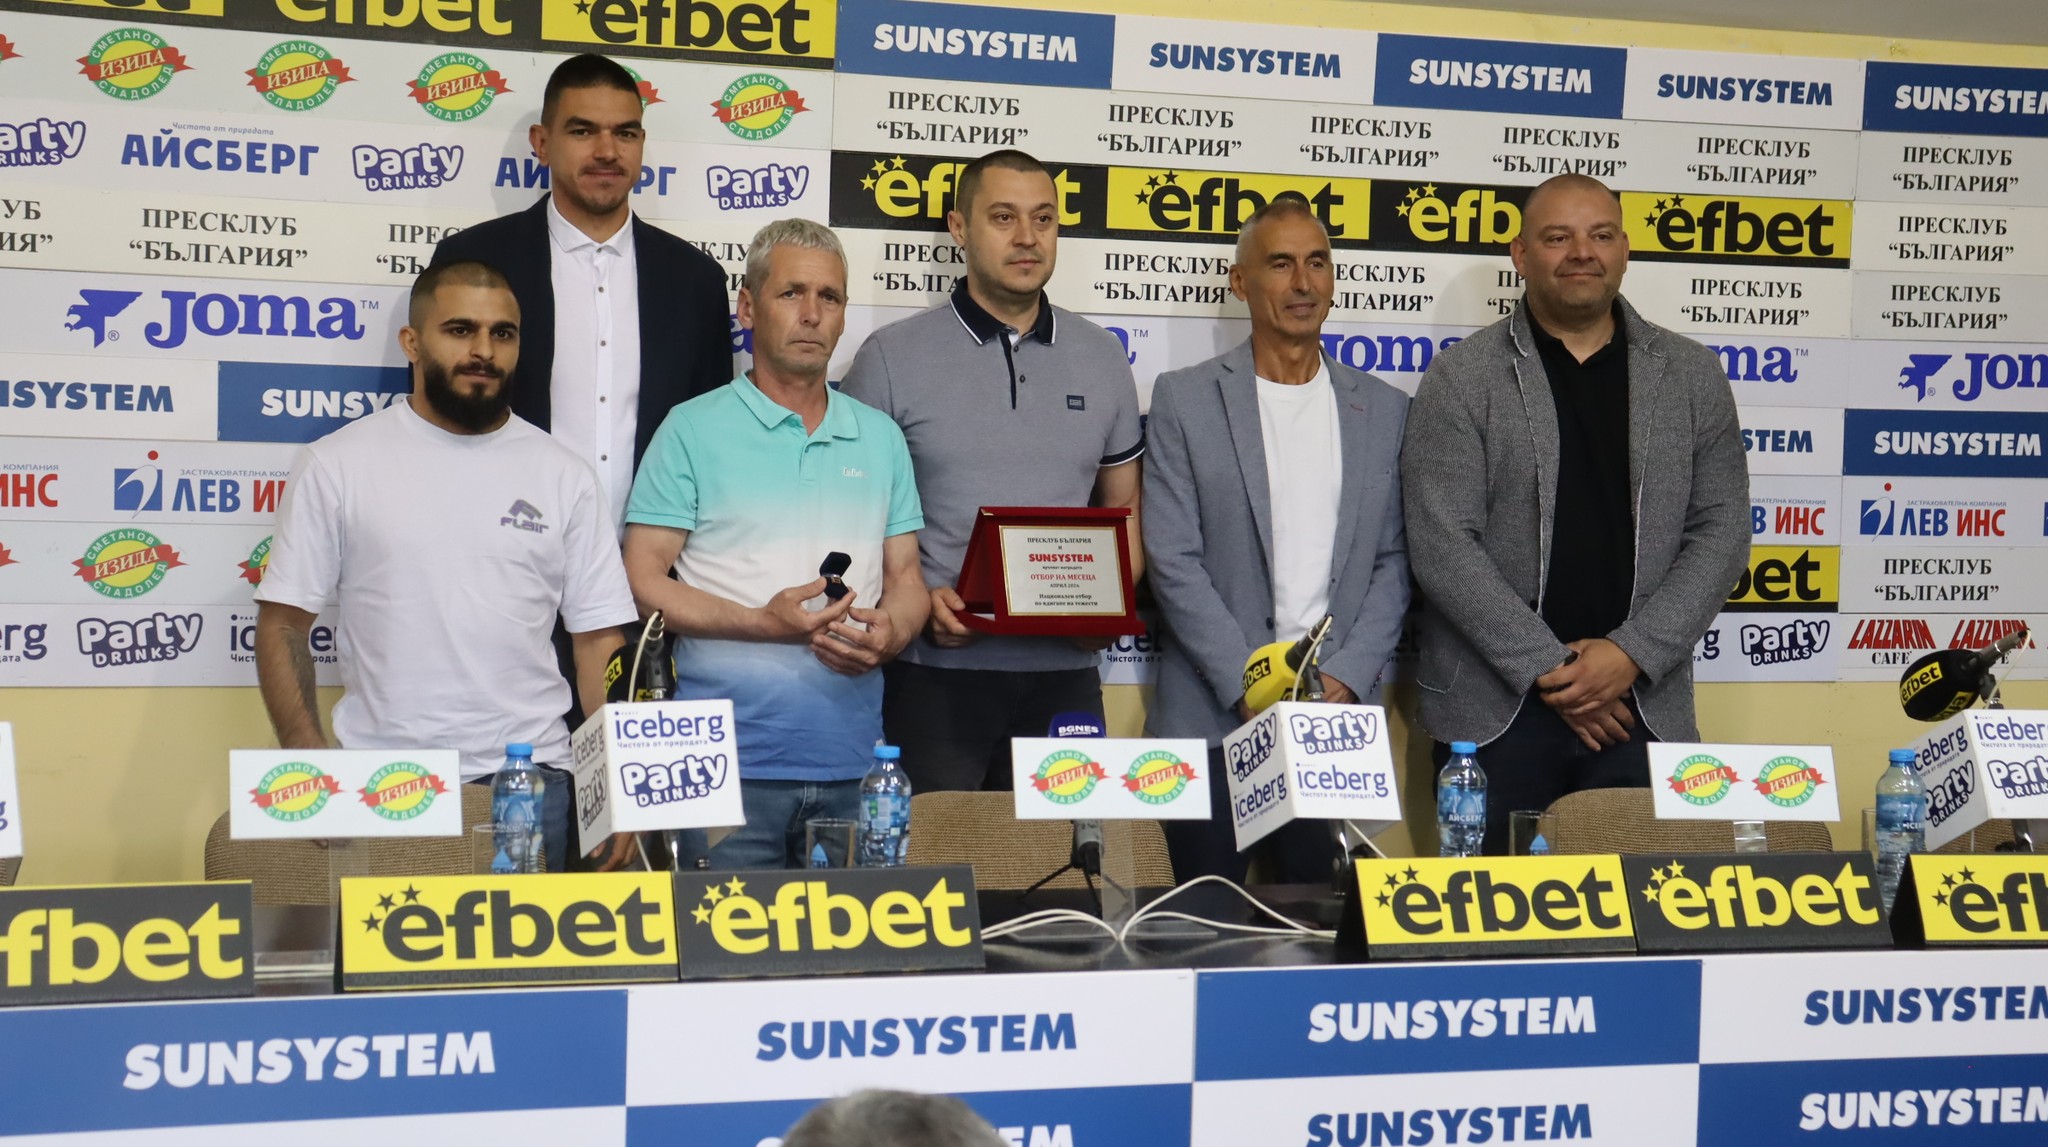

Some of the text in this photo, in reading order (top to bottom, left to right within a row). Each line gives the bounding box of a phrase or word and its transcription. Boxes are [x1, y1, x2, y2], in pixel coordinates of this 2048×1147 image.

[91, 29, 161, 59] СМЕТАНОВ
[260, 42, 326, 71] СМЕТАНОВ
[873, 23, 1078, 63] SUNSYSTEM
[99, 48, 166, 78] ИЗИДА
[420, 54, 483, 82] СМЕТАНОВ
[1149, 42, 1341, 78] SUNSYSTEM
[98, 63, 174, 100] СЛАДОЛЕД
[267, 61, 330, 90] ИЗИДА
[426, 73, 488, 100] ИЗИДА
[724, 76, 783, 102] СМЕТАНОВ
[1408, 58, 1592, 94] SUNSYSTEM
[1657, 73, 1833, 106] SUNSYSTEM
[265, 77, 338, 111] СЛАДОЛЕД
[425, 89, 495, 121] СЛАДОЛЕД
[729, 92, 788, 120] ИЗИДА
[888, 91, 1020, 116] ПРЕСКЛУБ
[728, 107, 794, 140] СЛАДОЛЕД
[1108, 104, 1235, 129] ПРЕСКЛУБ
[1311, 116, 1432, 139] ПРЕСКЛУБ
[0, 119, 85, 157] arty
[121, 128, 319, 176] АЙСБЕРГ
[1503, 126, 1620, 150] ПРЕСКЛУБ
[1697, 136, 1811, 159] ПРЕСКЛУБ
[354, 145, 463, 180] Party
[1902, 146, 2013, 167] ПРЕСКЛУБ
[369, 176, 441, 190] DRINKS
[708, 165, 808, 198] Party
[721, 196, 788, 209] DRINKS
[1149, 177, 1345, 237] efbt
[142, 208, 297, 236] ПРЕСКЛУБ
[1656, 200, 1834, 256] efbet
[1898, 215, 2008, 236] ПРЕСКЛУБ
[884, 243, 967, 264] ПРЕСК
[1104, 253, 1229, 276] ПРЕСКЛУБ
[1335, 263, 1425, 284] ЕСКЛУБ
[1690, 278, 1803, 300] ПРЕСКЛУБ
[1891, 283, 2001, 305] ПРЕСКЛУБ
[144, 290, 366, 349] Joma
[261, 388, 405, 420] SUNSY
[1874, 430, 2041, 456] SUNSYSTEM
[180, 469, 267, 477] ЗАСТРАХОВАТЕЛНА
[172, 478, 241, 512] ЛЕВ
[1775, 506, 1826, 536] ИНС
[1900, 508, 2006, 537] ЛЕВ ИНС
[87, 531, 154, 560] СМЕТАНОВ
[1028, 553, 1094, 562] SUNSYSTEM
[93, 548, 160, 578] ИЗИДА
[1884, 559, 1992, 575] ПРЕСКЛУБ
[93, 561, 168, 597] СЛАДОЛЕД
[78, 613, 202, 653] Party
[1742, 621, 1829, 652] Party
[1847, 619, 1936, 650] LAZZARIN
[95, 647, 177, 667] DRINKS
[1753, 650, 1811, 665] DRINKS
[614, 710, 725, 742] iceberg
[1291, 712, 1376, 743] Party
[1974, 716, 2048, 741] iceber
[1230, 713, 1276, 774] Party
[1306, 739, 1364, 754] DRINKS
[1914, 725, 1968, 772] ceberg
[260, 763, 317, 790] СМЕТАНОВ
[368, 763, 424, 789] СМЕТАНОВ
[621, 755, 727, 795] Party
[1038, 751, 1087, 775] СМЕТАНОВ
[1047, 763, 1094, 789] ИЗИДА
[1129, 752, 1177, 776] СМЕТАНОВ
[1138, 765, 1185, 789] ИЗИДА
[1237, 747, 1270, 782] DRINKS
[1676, 756, 1720, 778] СМЕТАНОВ
[1760, 757, 1805, 779] СМЕТАНОВ
[270, 778, 326, 806] ИЗИДА
[378, 776, 433, 804] ИЗИДА
[1045, 776, 1097, 804] СЛАДОЛЕД
[1135, 777, 1188, 805] СЛАДОЛЕД
[1296, 763, 1389, 798] iceberg
[1681, 780, 1731, 806] СЛАДОЛЕД
[1684, 767, 1728, 792] ИЗИДА
[1767, 781, 1815, 807] СЛАДОЛЕД
[1769, 769, 1813, 793] ИЗИДА
[267, 790, 329, 821] СЛАДОЛЕД
[374, 789, 436, 820] СЛАДОЛЕД
[638, 785, 709, 806] DRINKS
[1234, 772, 1287, 821] iceberg
[1932, 794, 1968, 827] DRINKS
[1392, 866, 1622, 935] efbet
[1659, 861, 1880, 930] efbet
[382, 886, 666, 962] efbet
[711, 877, 972, 954] efbet
[1307, 996, 1597, 1043] SUNSYSTEM
[756, 1012, 1078, 1062] SUNSYSTEM
[123, 1031, 495, 1090] SUNSYSTEM
[1306, 1104, 1592, 1147] SUNSYSTEM
